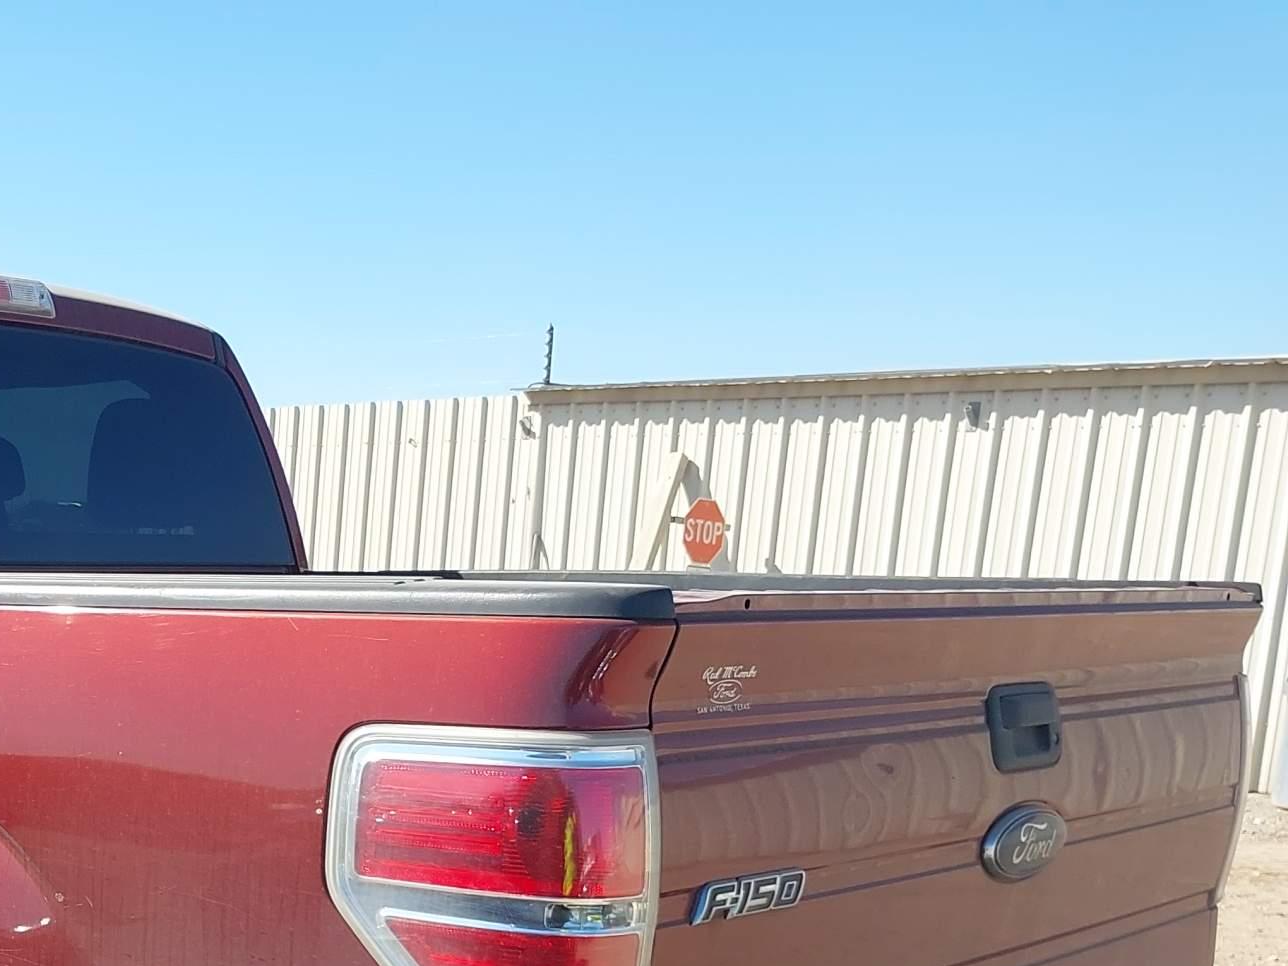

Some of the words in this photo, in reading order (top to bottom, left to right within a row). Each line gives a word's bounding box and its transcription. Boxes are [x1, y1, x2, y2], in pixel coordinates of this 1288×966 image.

[684, 518, 723, 545] STOP
[713, 683, 737, 699] Ford
[1012, 822, 1057, 865] Ford
